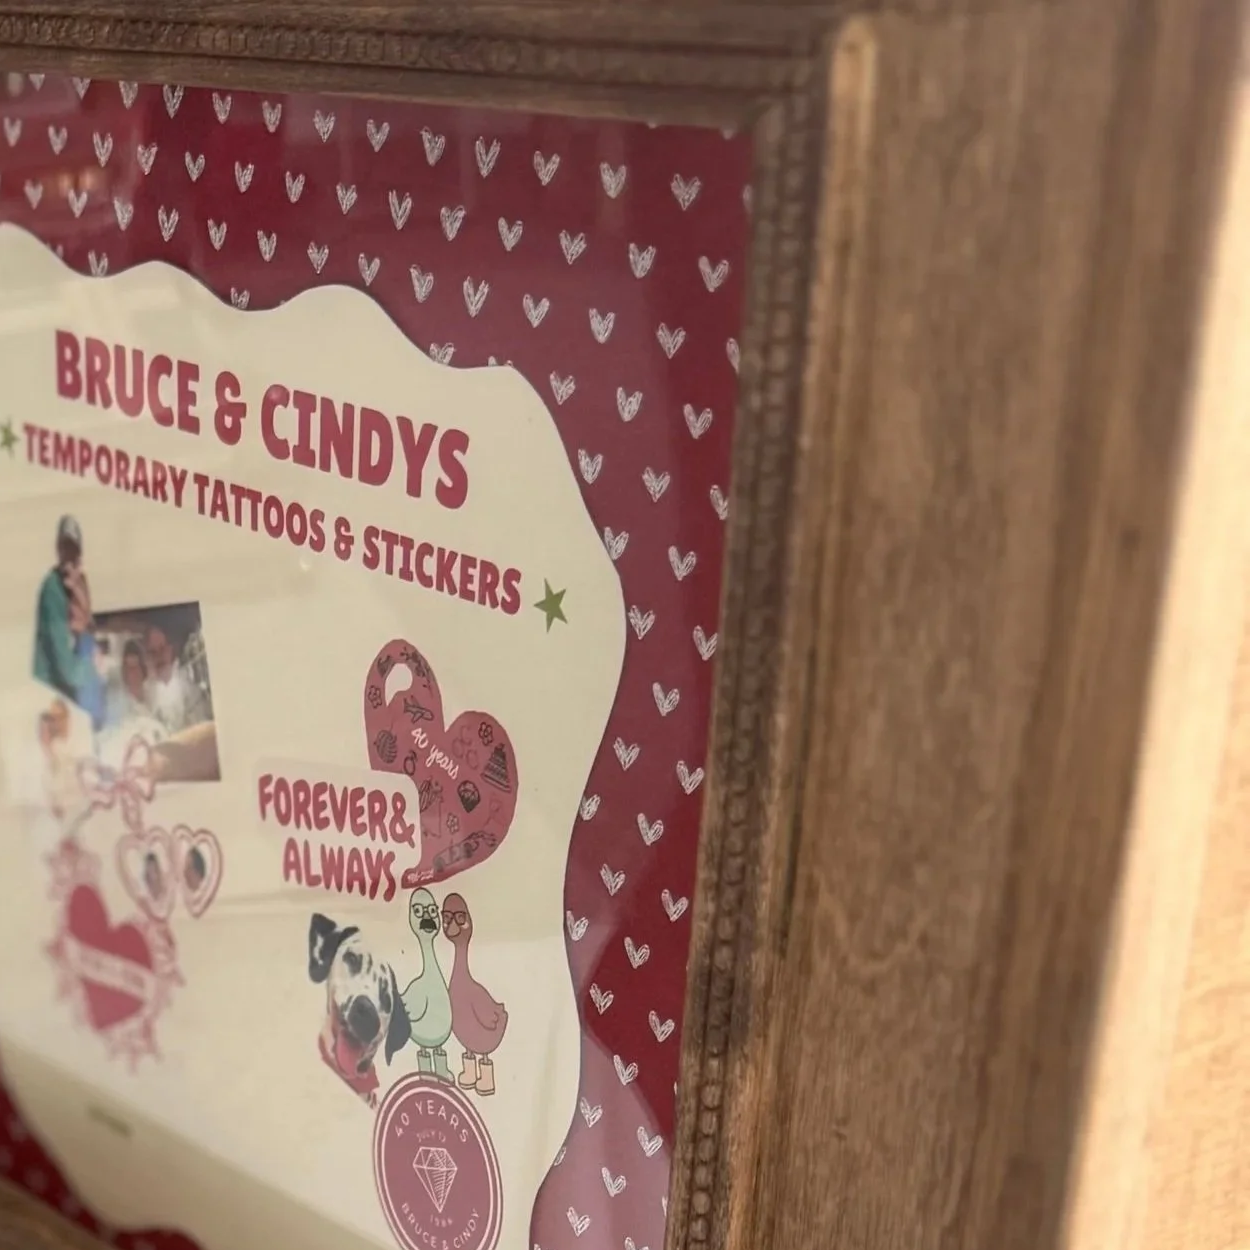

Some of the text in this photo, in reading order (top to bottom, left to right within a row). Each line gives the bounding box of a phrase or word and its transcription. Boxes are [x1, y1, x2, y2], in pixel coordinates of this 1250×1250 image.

[55, 329, 469, 510] BRUCE & CINDYS
[24, 424, 522, 616] TEMPORARY TATTOOS & STICKERS
[411, 727, 459, 780] 40 years
[283, 837, 396, 902] ALWAYS
[394, 1099, 469, 1143] 40 YEARS
[401, 1202, 437, 1249] BRUCE
[453, 1207, 480, 1249] CINDY
